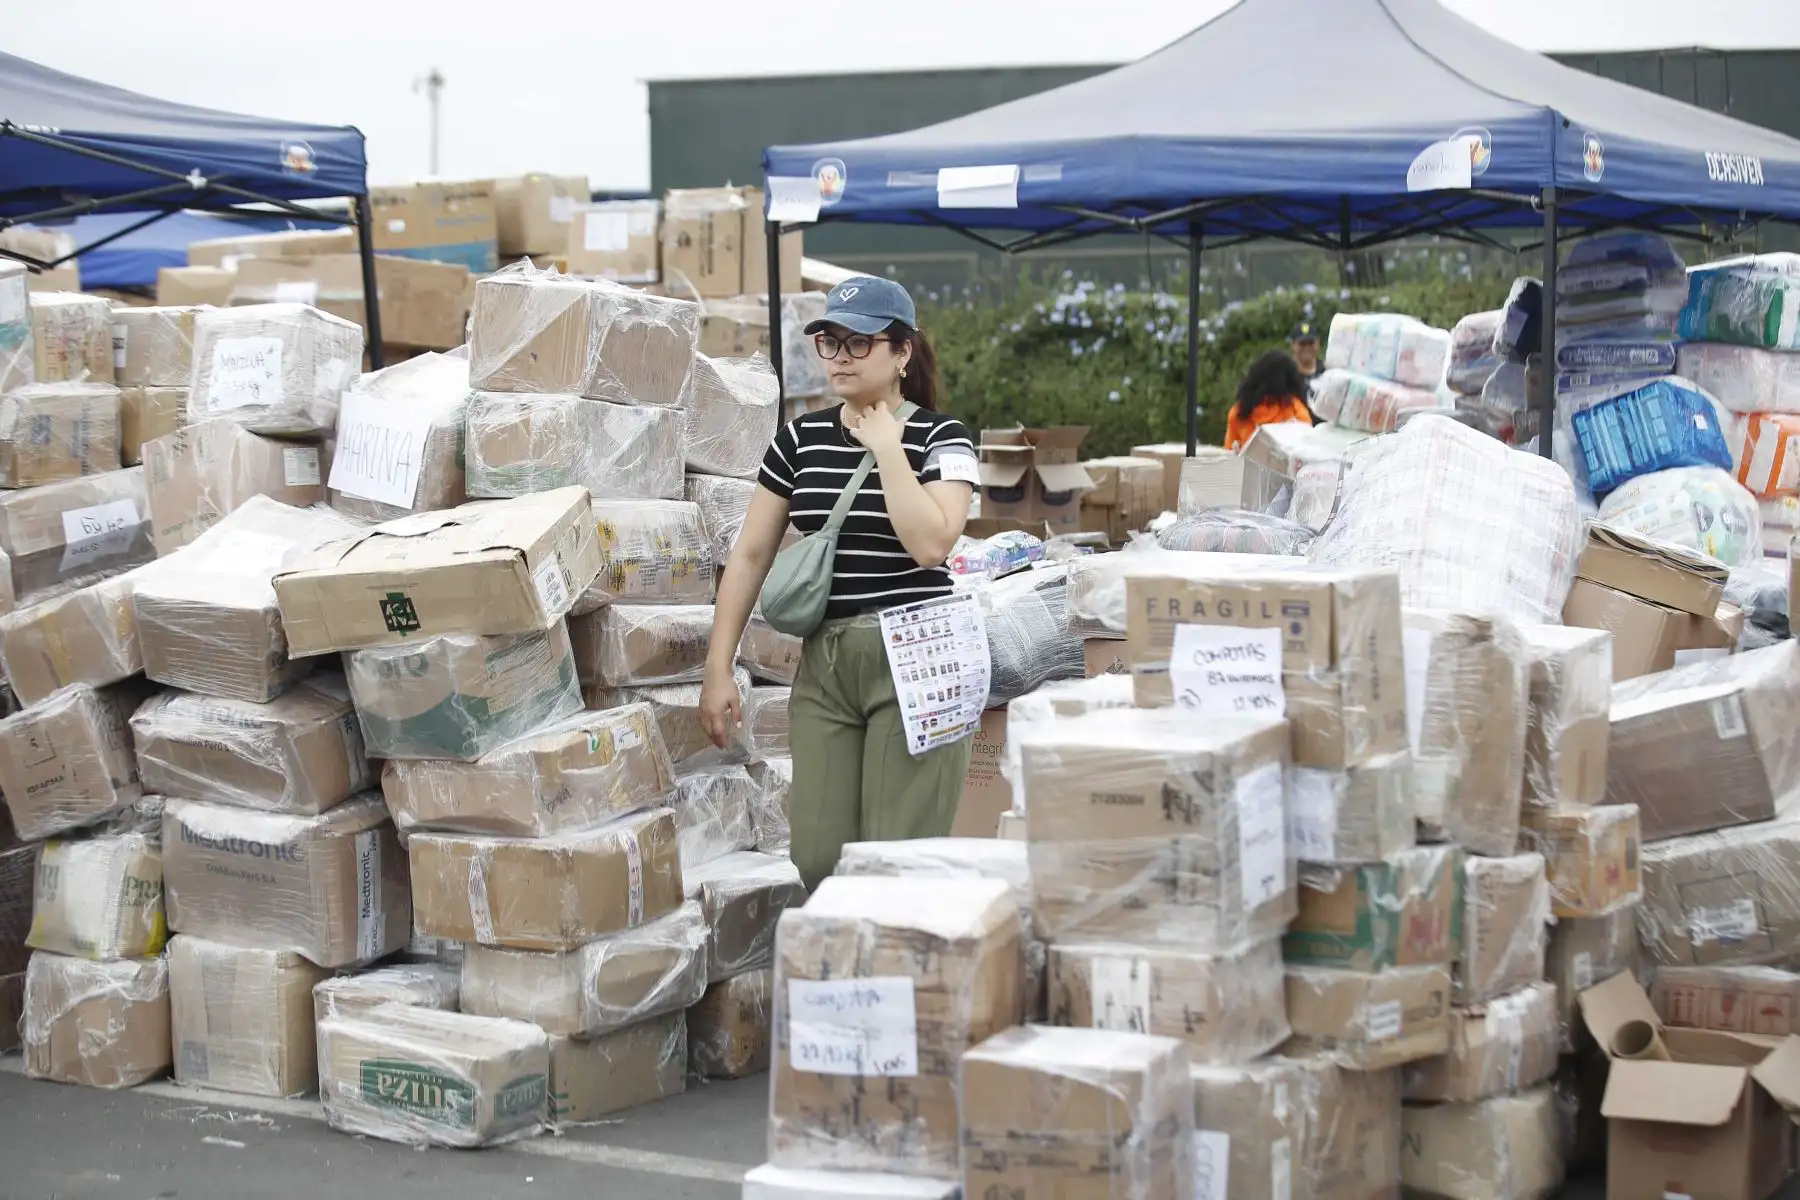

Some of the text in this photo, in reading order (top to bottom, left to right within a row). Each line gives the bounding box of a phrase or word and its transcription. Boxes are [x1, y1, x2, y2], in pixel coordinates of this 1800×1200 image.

[1146, 597, 1273, 619] FRAGIL
[971, 742, 1004, 758] ntegri
[361, 851, 371, 919] Medtronic
